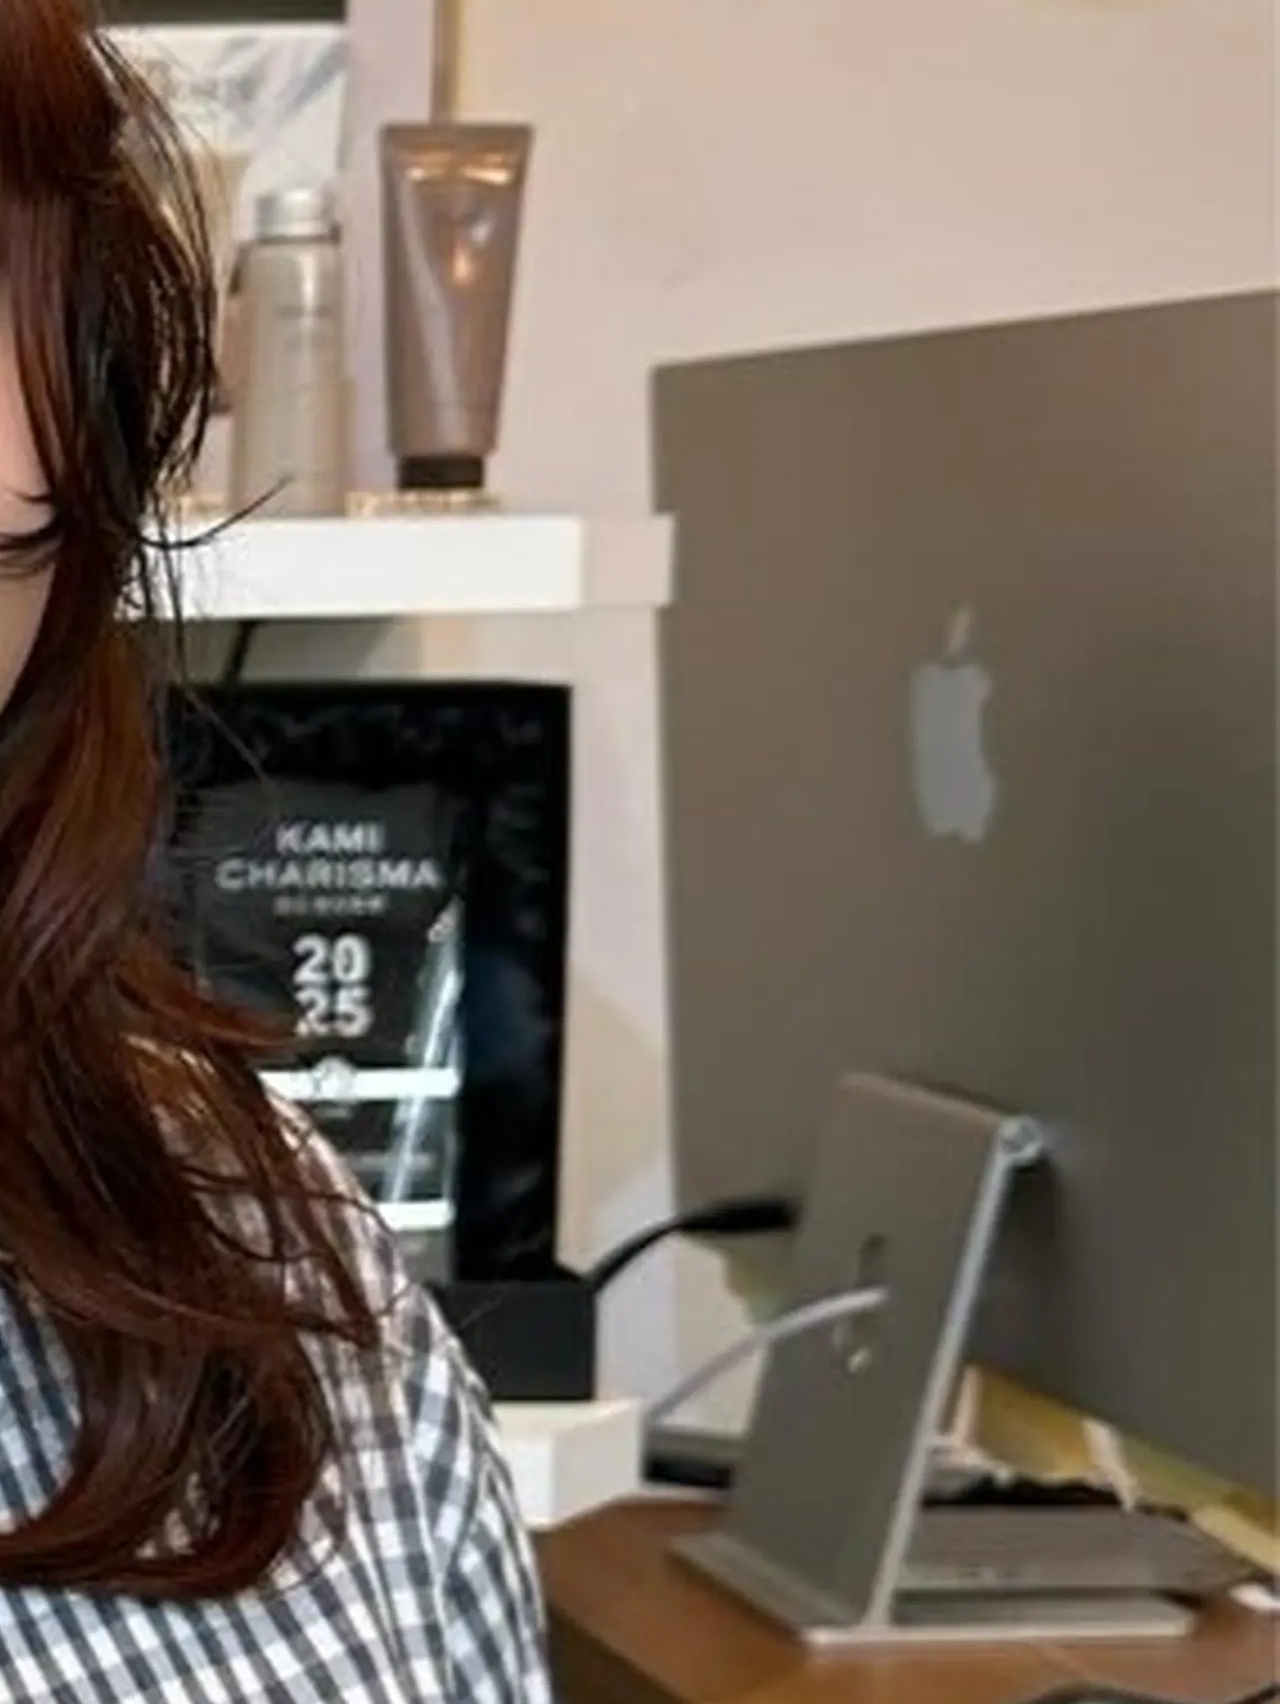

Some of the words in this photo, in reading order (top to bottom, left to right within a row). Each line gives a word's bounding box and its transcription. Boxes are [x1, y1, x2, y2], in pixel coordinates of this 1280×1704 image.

[274, 820, 386, 854] KAMI
[214, 857, 442, 890] CHARISMA
[292, 931, 370, 984] 20
[293, 985, 374, 1037] 25
